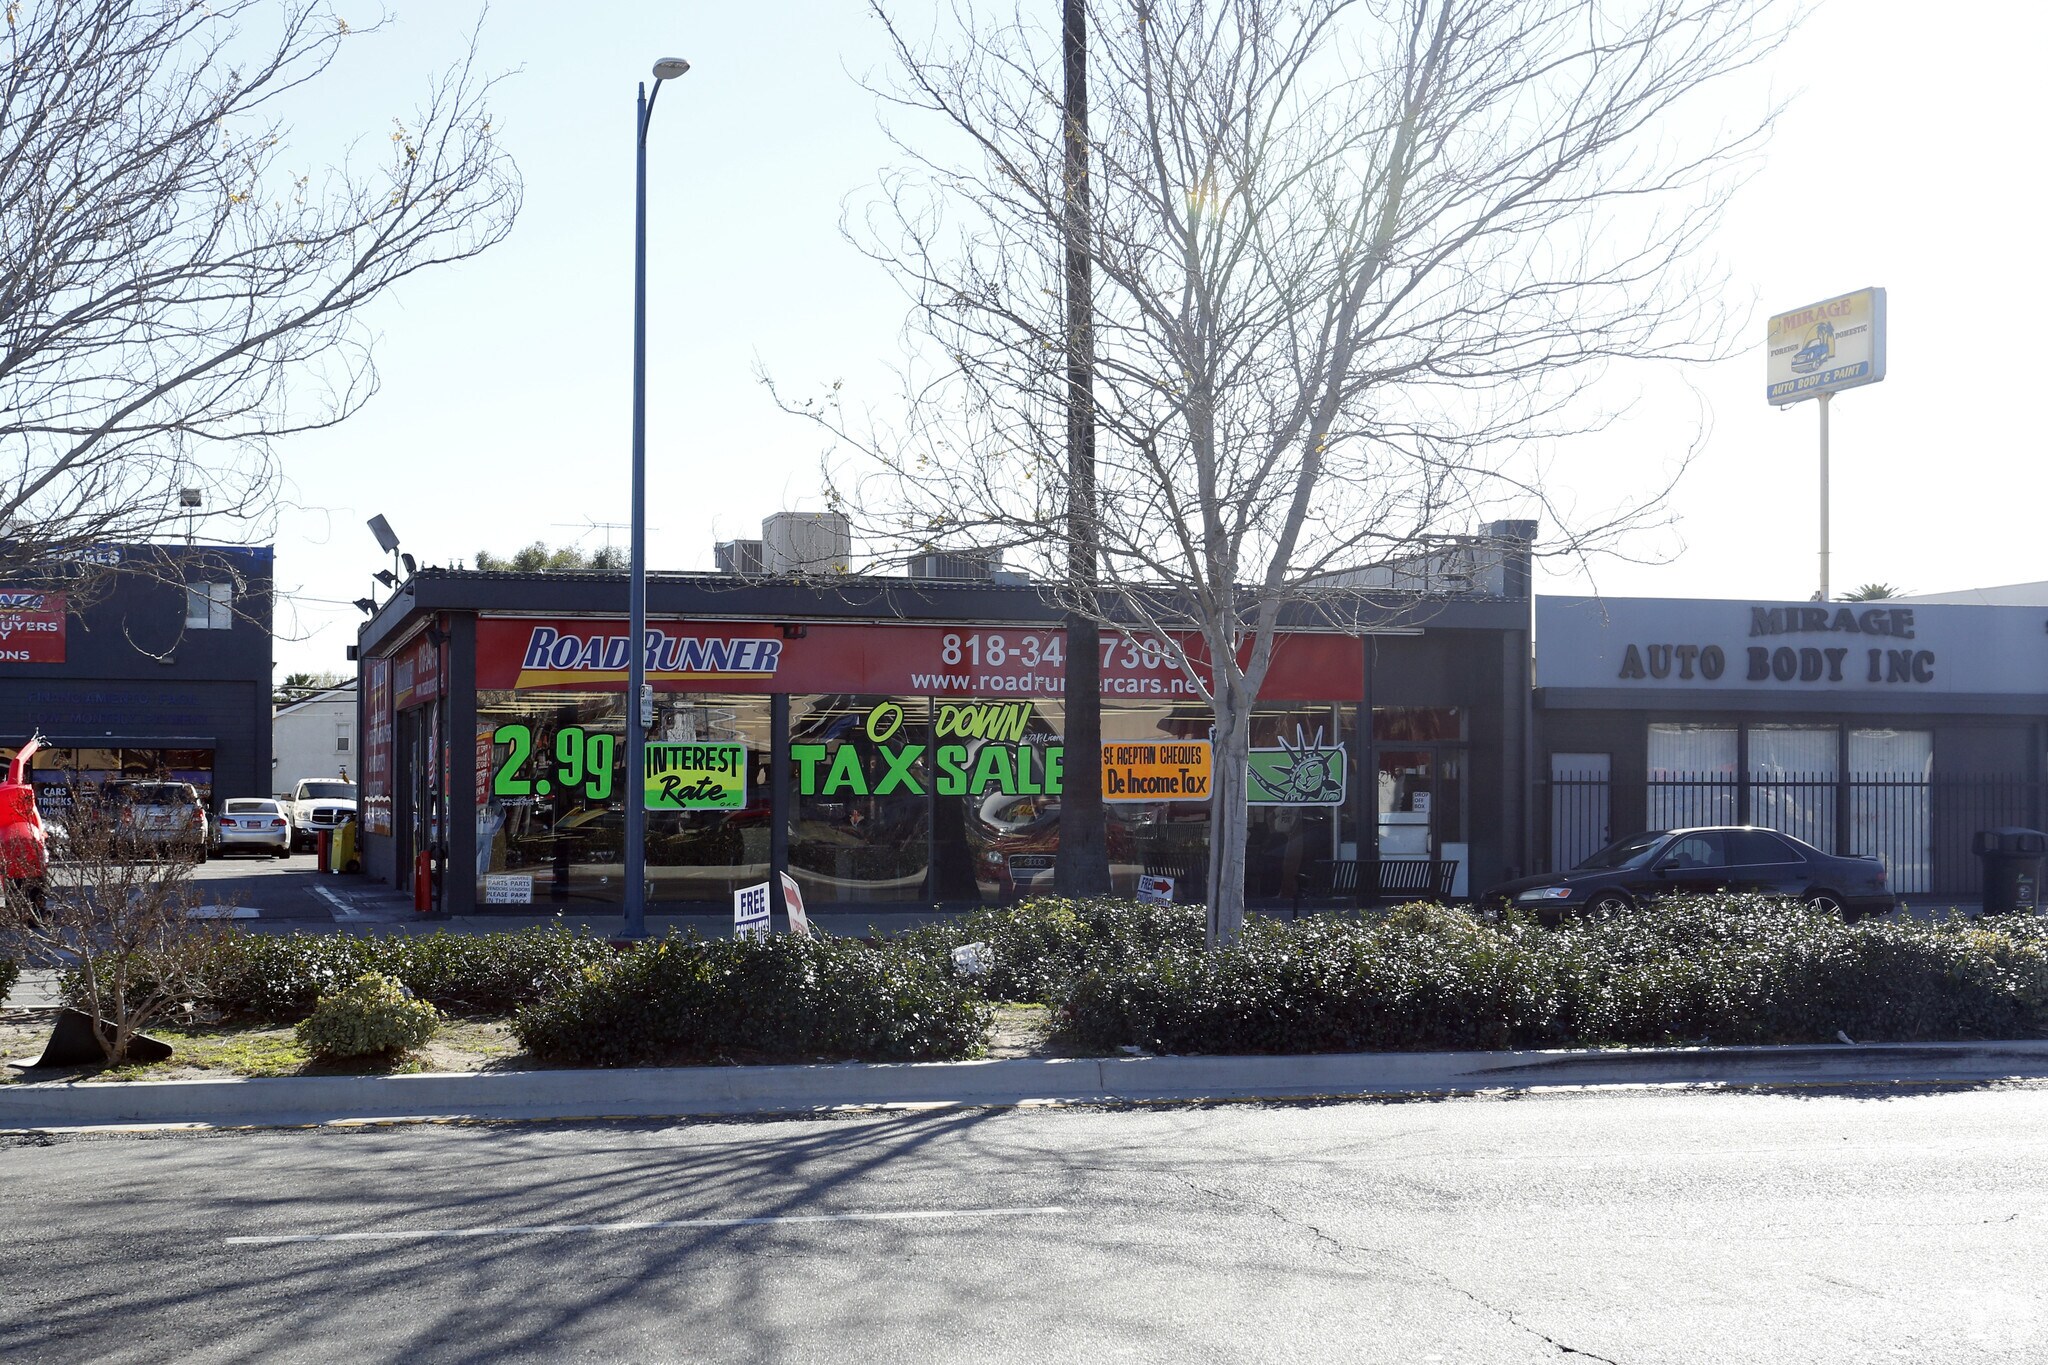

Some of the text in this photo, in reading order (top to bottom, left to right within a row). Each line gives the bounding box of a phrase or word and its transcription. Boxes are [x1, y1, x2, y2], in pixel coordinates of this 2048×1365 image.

[1783, 299, 1851, 333] MIRAGE
[1835, 324, 1868, 340] DOMESTIC
[1770, 344, 1799, 357] FOREIGN
[1772, 364, 1861, 396] AUTO BODY & PAINT
[1749, 606, 1915, 640] MIRAGE
[1618, 644, 1935, 684] AUTO BODY INC
[911, 670, 1208, 694] www.roadrurcars.net
[935, 701, 1034, 743] DOWN
[493, 724, 615, 800] 2.99
[646, 746, 741, 779] INTEREST
[790, 743, 1065, 796] TAX SALE
[1104, 746, 1202, 765] SE ACEPTAN CHEQUES
[43, 787, 67, 796] CARS
[659, 775, 728, 808] Rate
[1107, 768, 1207, 794] De Income Tax
[38, 797, 72, 806] TRUCKS
[42, 807, 67, 816] VANS
[740, 888, 765, 917] FREE
